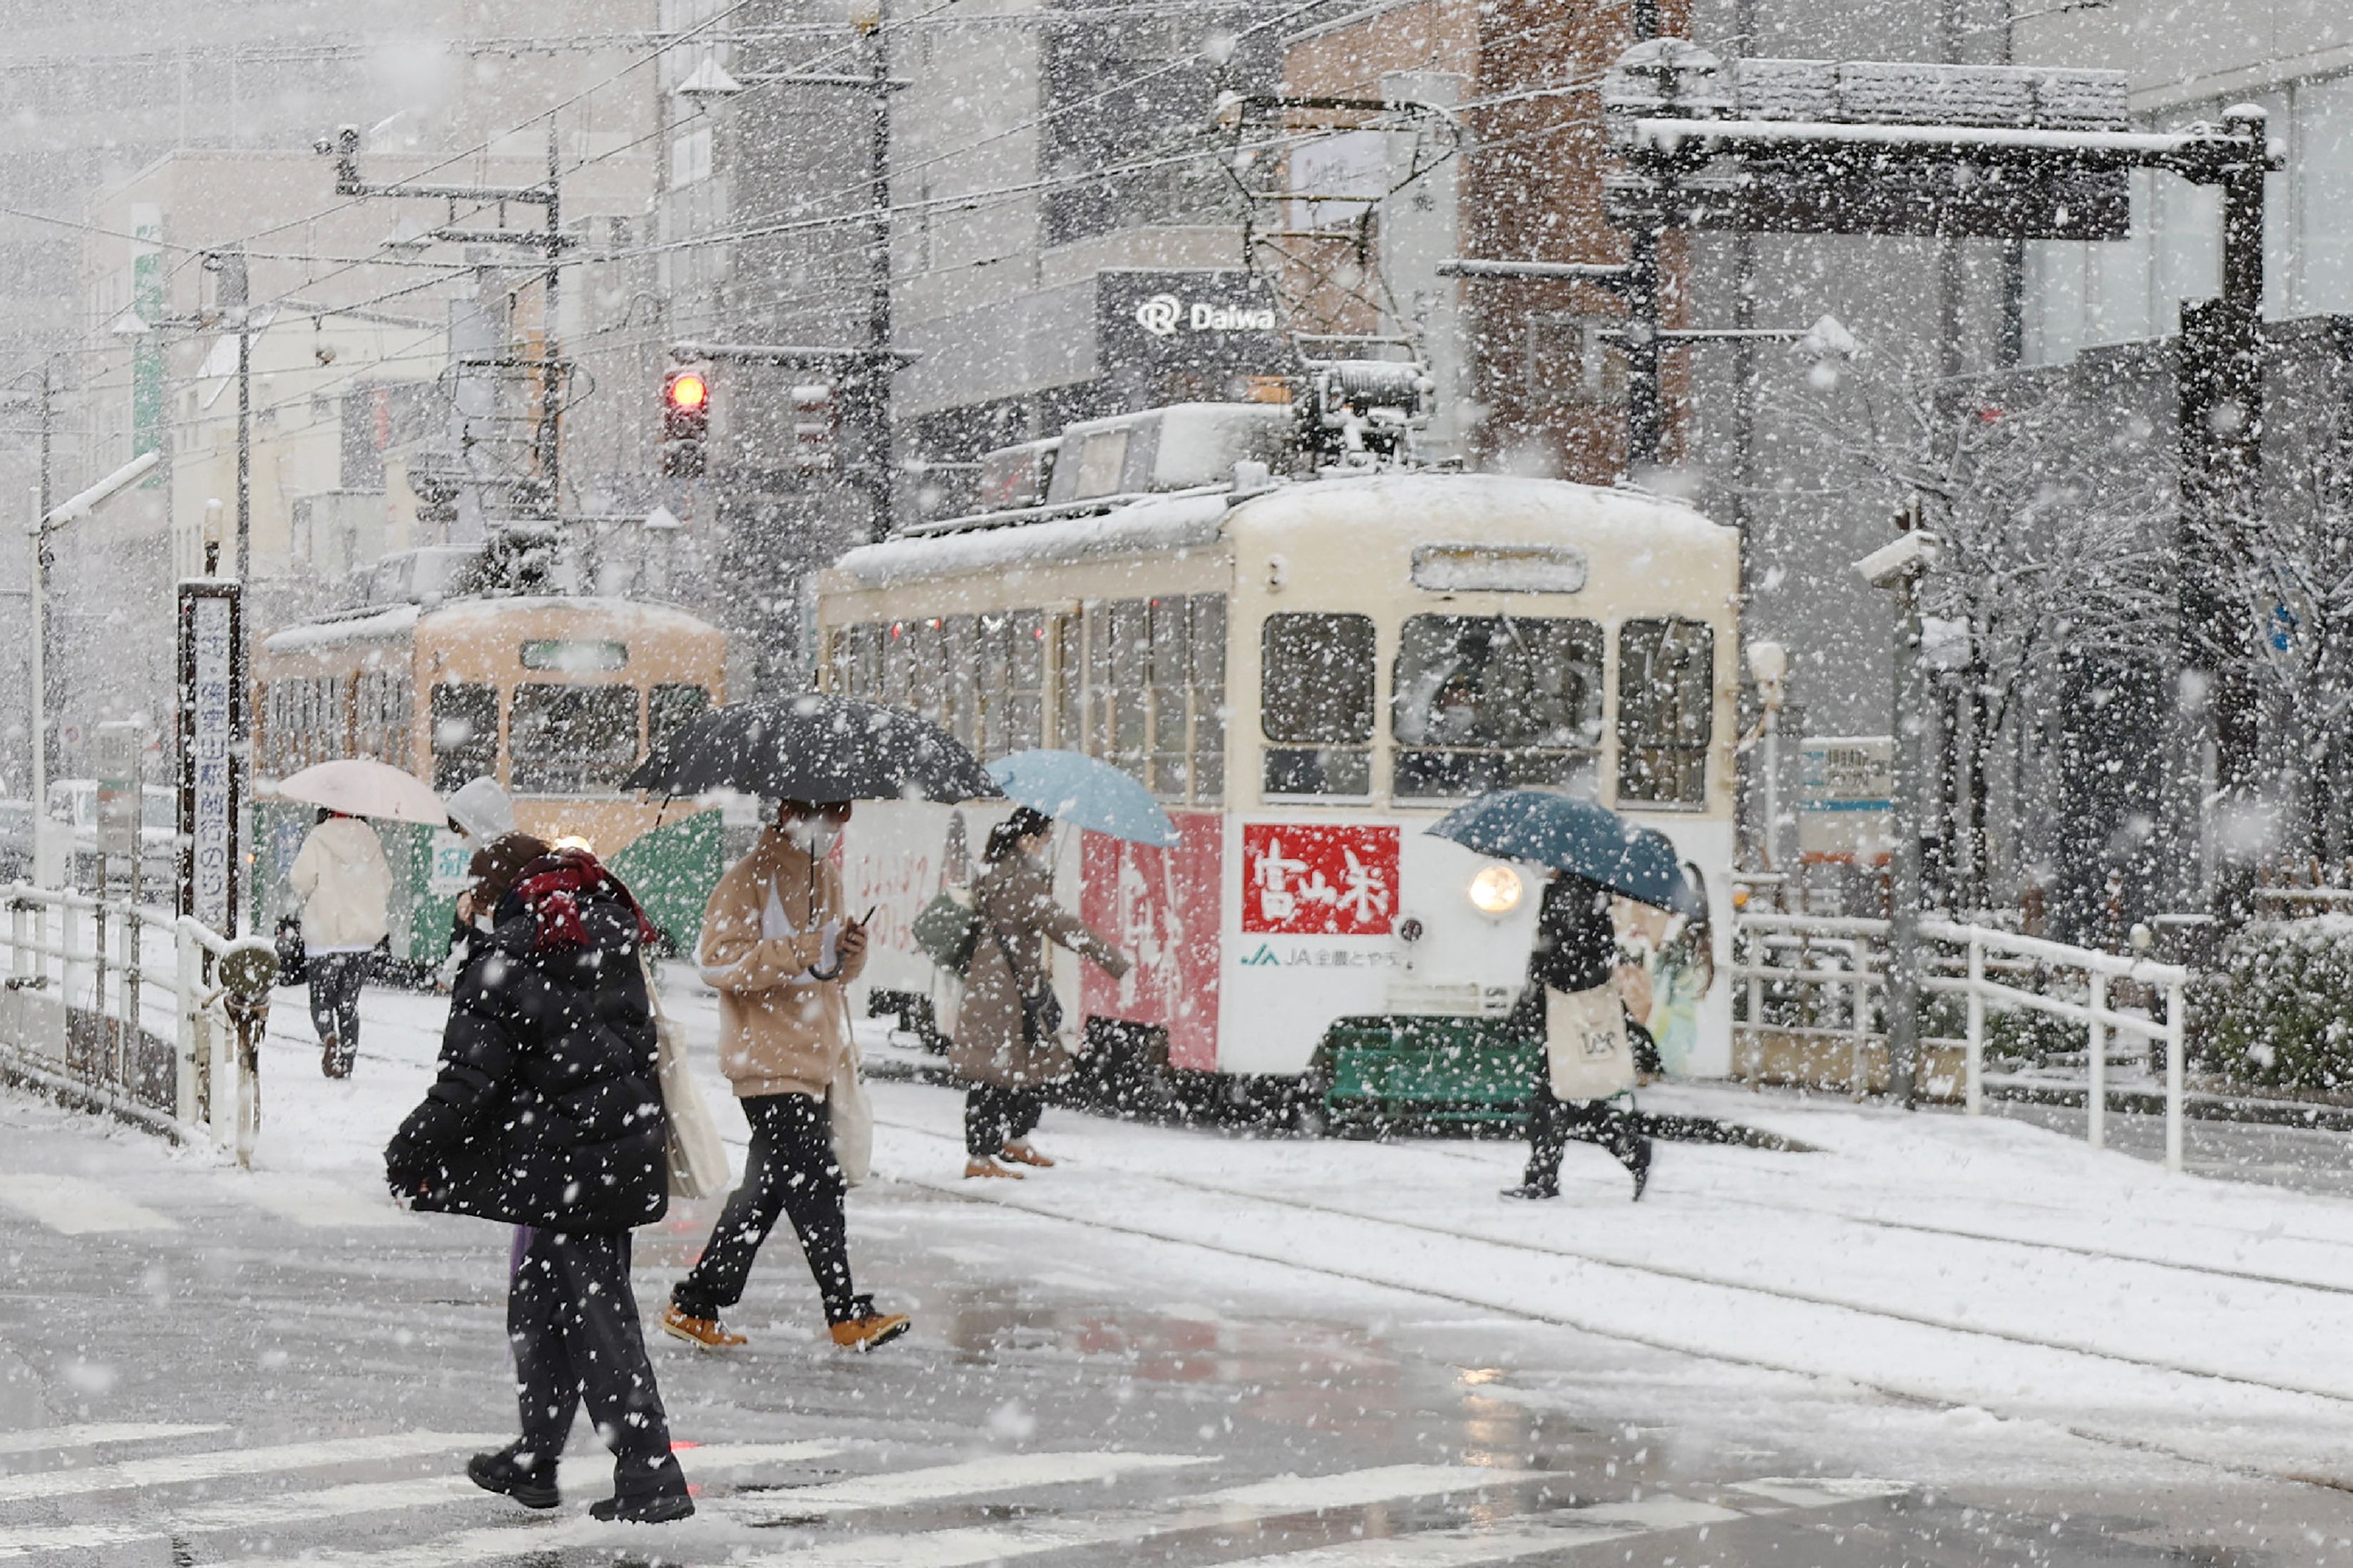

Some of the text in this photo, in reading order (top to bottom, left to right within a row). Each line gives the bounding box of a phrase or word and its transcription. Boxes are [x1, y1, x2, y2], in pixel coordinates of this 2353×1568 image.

[1190, 302, 1276, 330] Daiwa
[1252, 837, 1390, 923] 富山米
